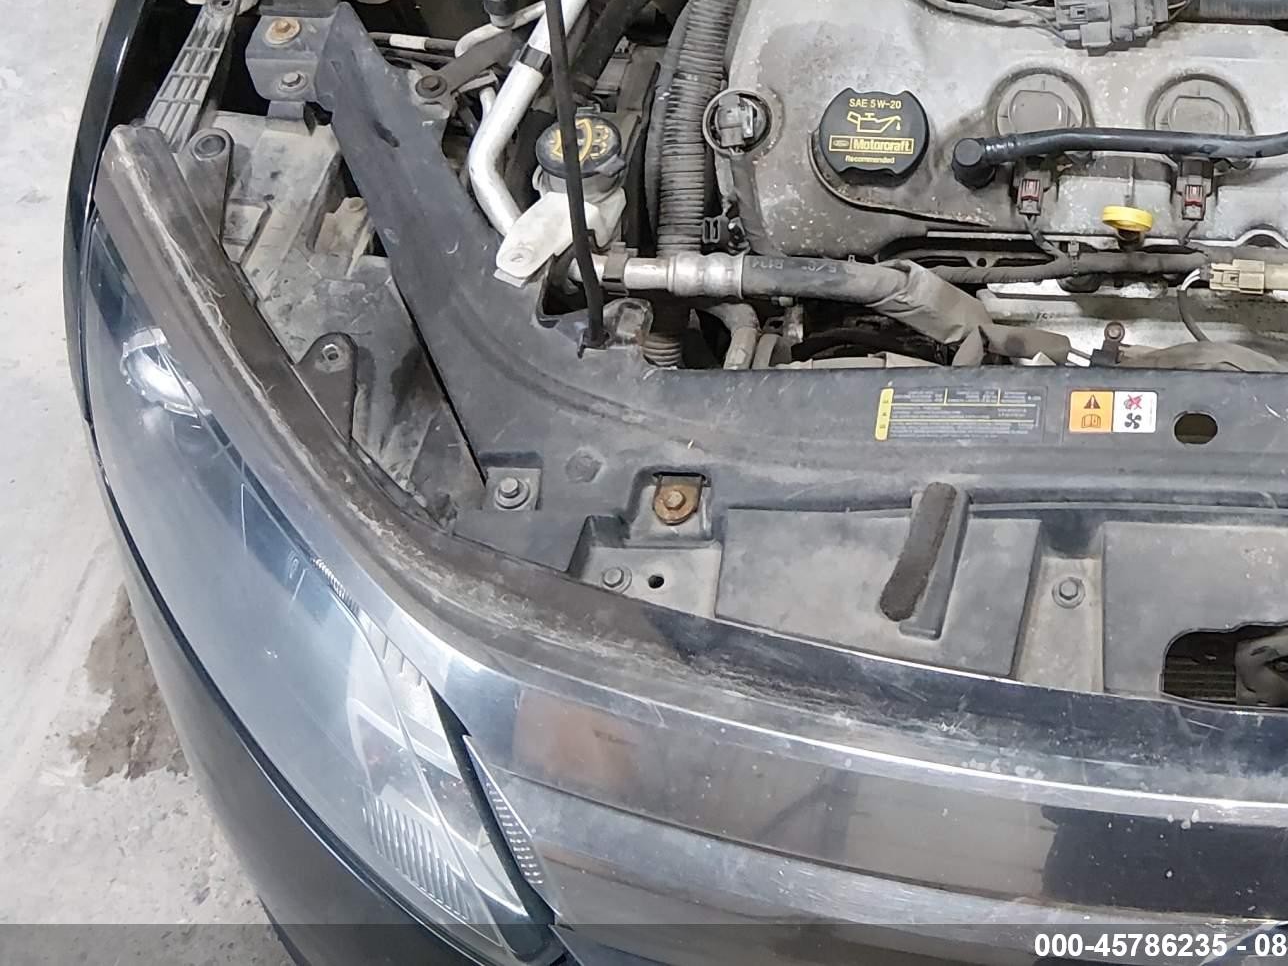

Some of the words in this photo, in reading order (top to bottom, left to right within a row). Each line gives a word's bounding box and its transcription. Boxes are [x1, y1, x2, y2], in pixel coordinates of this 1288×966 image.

[849, 98, 868, 108] SAE
[870, 100, 902, 109] 5W-20
[854, 138, 911, 152] Motorcraft
[845, 155, 895, 164] Recommended
